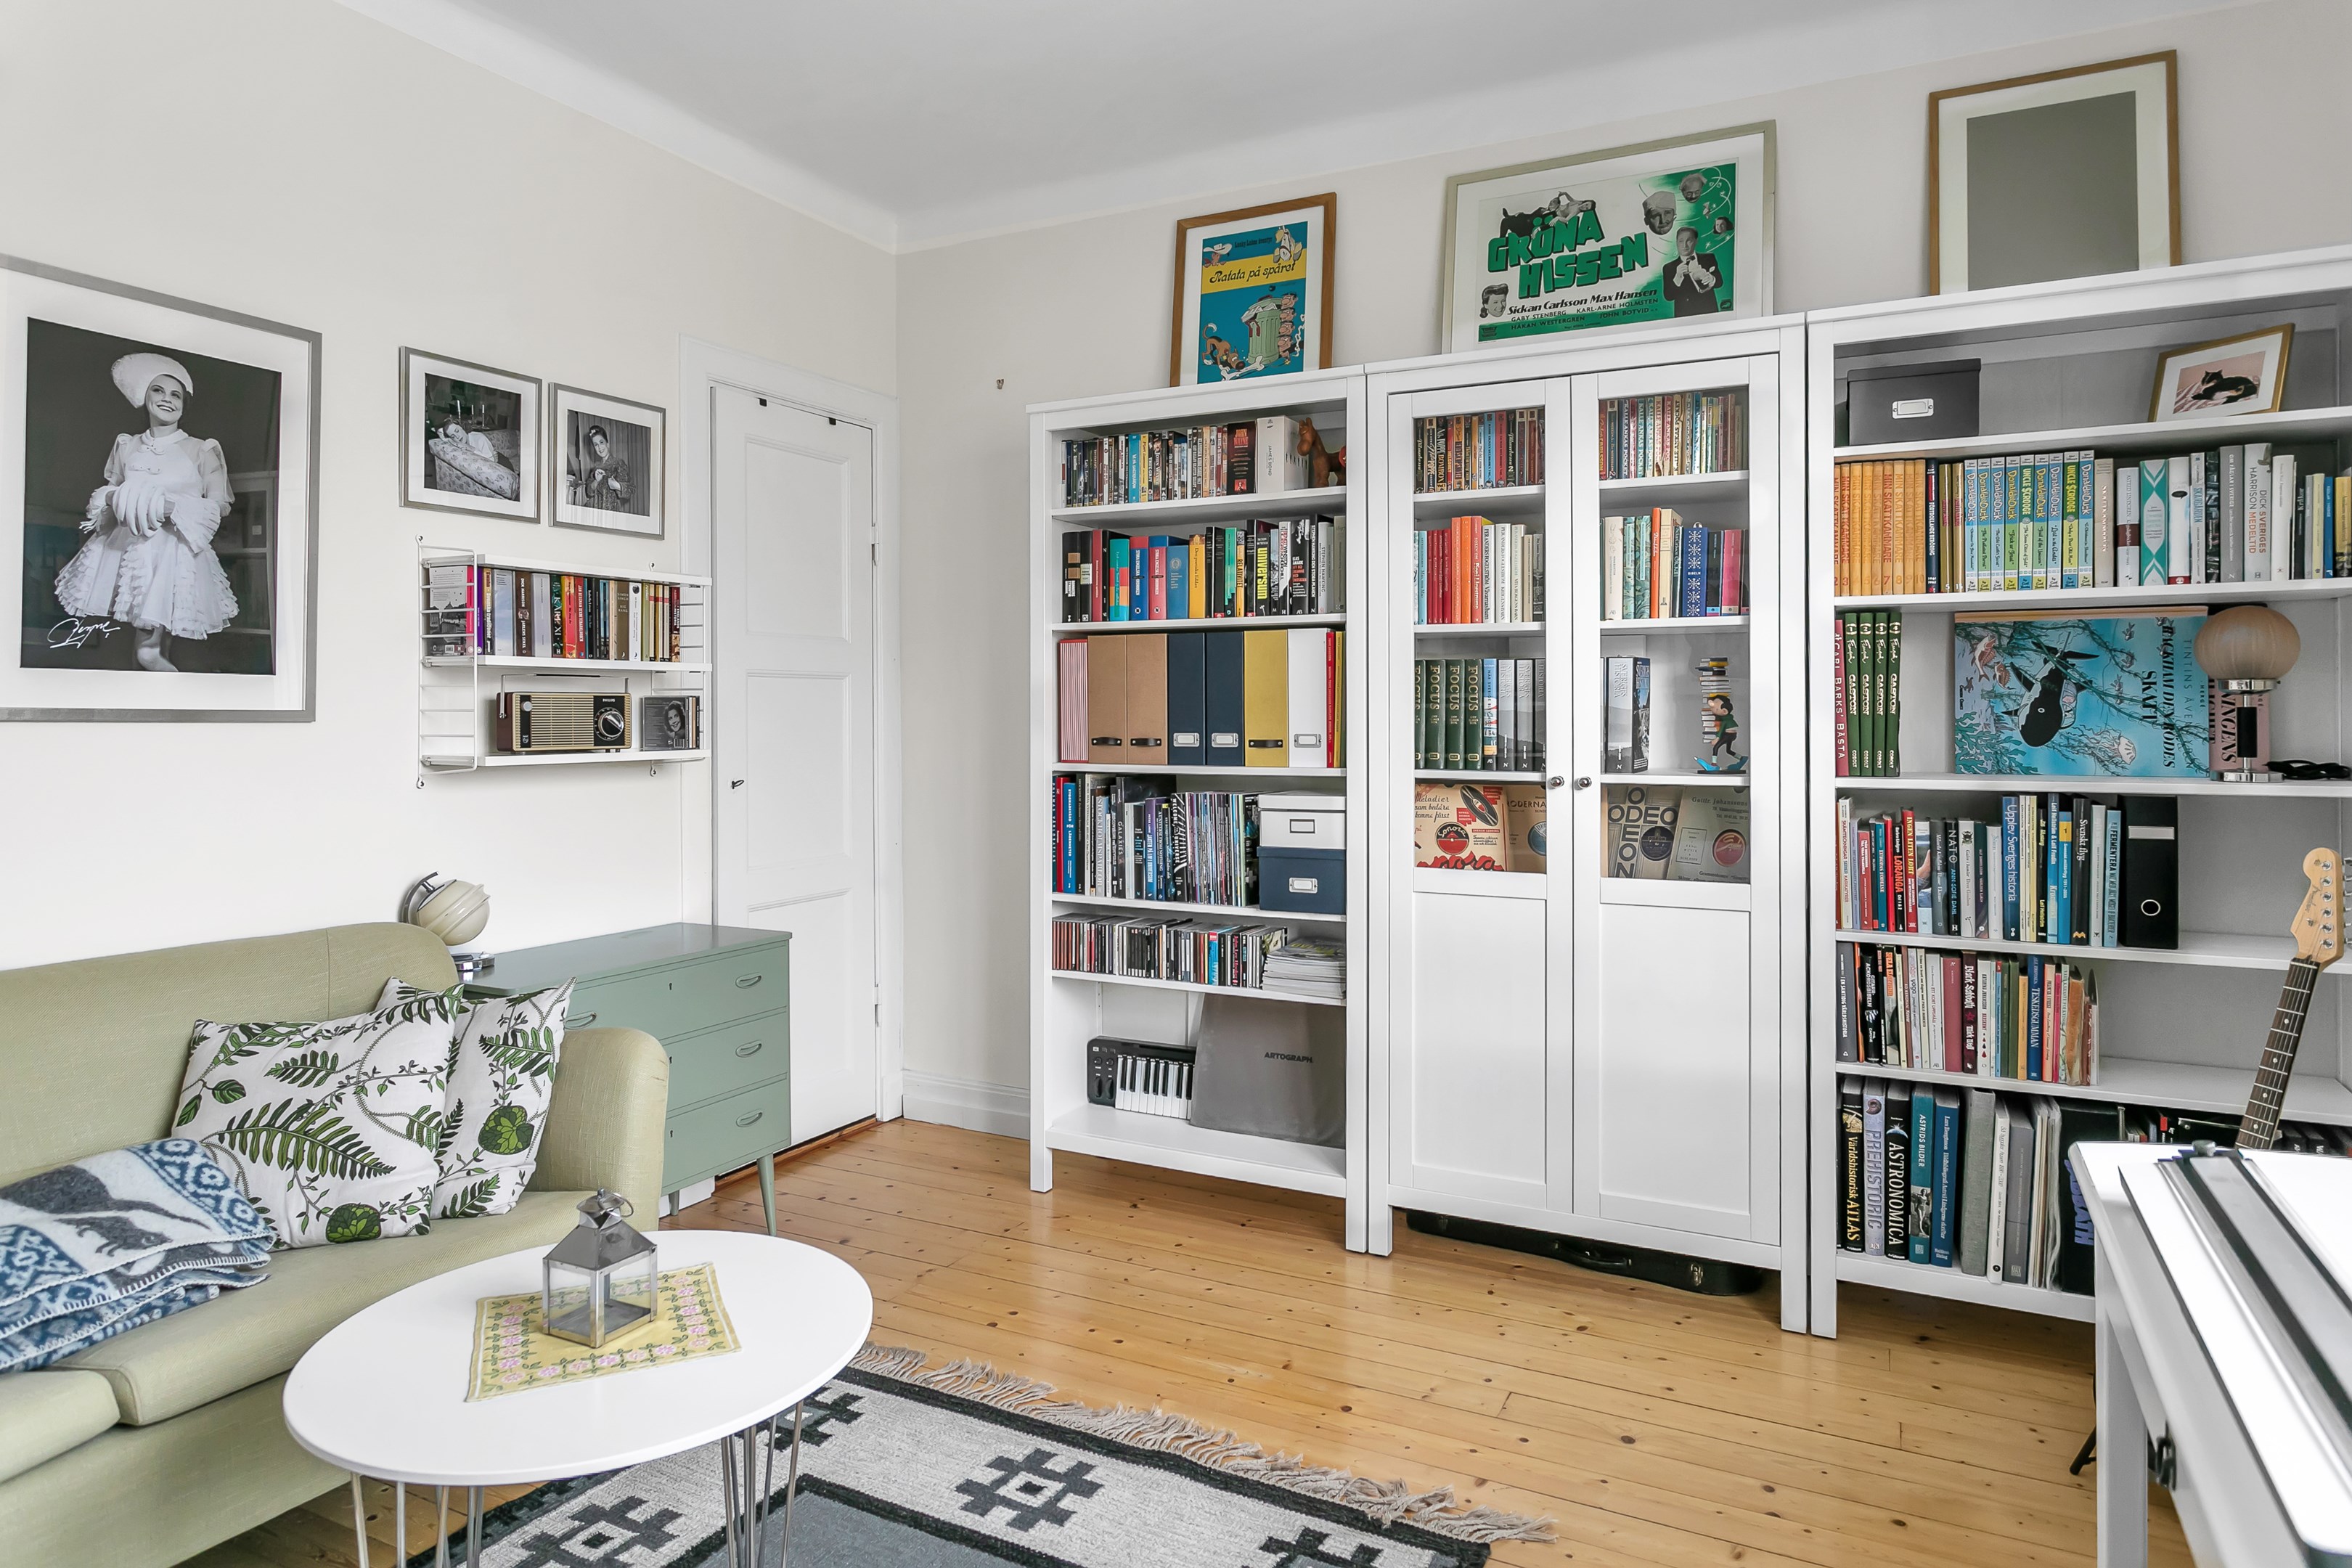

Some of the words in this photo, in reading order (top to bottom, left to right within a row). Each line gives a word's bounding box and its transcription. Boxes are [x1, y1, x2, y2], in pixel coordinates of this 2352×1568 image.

[1488, 208, 1605, 272] GRÖNA
[1209, 268, 1245, 284] Ratata
[1246, 266, 1260, 282] på
[1262, 260, 1296, 279] spåret
[1519, 232, 1649, 299] HISSEN
[1507, 304, 1542, 315] Sickan
[1543, 297, 1588, 309] Carlsson
[1590, 294, 1614, 305] Max
[1614, 289, 1657, 301] Hansen
[1532, 310, 1567, 319] STENBERG
[1576, 303, 1617, 314] KARL-ARNE
[1620, 298, 1659, 309] HOLMSTEN
[1511, 322, 1536, 330] HÅKAN
[1539, 316, 1585, 326] WESTERGREN
[1622, 307, 1649, 316] BOTVID
[1967, 473, 1976, 498] Donald
[1979, 472, 1989, 497] Donald
[1993, 471, 2003, 497] Donald
[2006, 470, 2017, 497] Donald
[2022, 468, 2031, 487] UNCLE
[2066, 465, 2076, 484] UNCLE
[2249, 467, 2258, 510] HARRISON
[1980, 499, 1989, 521] Duck
[1993, 499, 2003, 520] Duck
[2008, 499, 2017, 520] Duck
[2021, 487, 2032, 515] $CROOGE
[2065, 485, 2077, 513] $CROOGE
[2194, 487, 2203, 523] SKÄRGÅRDEN
[1883, 494, 1892, 563] SKATTKAMMARE
[1257, 547, 1268, 600] universum
[555, 626, 561, 636] XI
[2162, 625, 2175, 690] RACKHAM
[2184, 640, 2192, 689] TINTINS
[1430, 665, 1440, 710] FOCUS
[1450, 665, 1460, 711] FOCUS
[1468, 665, 1479, 711] FOCUS
[2141, 670, 2157, 724] SKATT
[2163, 692, 2175, 722] DEN
[1837, 723, 1846, 759] BÄSTA
[2163, 722, 2179, 767] RÖDES
[1434, 812, 1450, 822] först
[1712, 797, 1748, 807] Johanssons
[1437, 825, 1466, 838] Sonora
[2004, 804, 2017, 835] Upplev
[2079, 819, 2088, 846] Svenskt
[1948, 830, 1958, 863] NATO
[2005, 836, 2017, 870] Sveriges
[2076, 847, 2088, 861] flyg
[2109, 830, 2118, 871] FERMENTERA
[1894, 855, 1903, 893] LORANGA
[2008, 871, 2017, 902] historia
[1964, 965, 1975, 984] Black
[1964, 983, 1975, 1008] Sabbath
[2030, 987, 2041, 1048] TESKEDSGUMMAN
[1263, 1052, 1313, 1063] ARTOGRAPH
[1848, 1136, 1858, 1199] Världshistorisk
[1866, 1129, 1883, 1230] PREHISTORIC
[1888, 1142, 1905, 1245] ASTRONOMICA
[1847, 1199, 1861, 1241] ATLAS
[1940, 1199, 1948, 1221] Lindgrens
